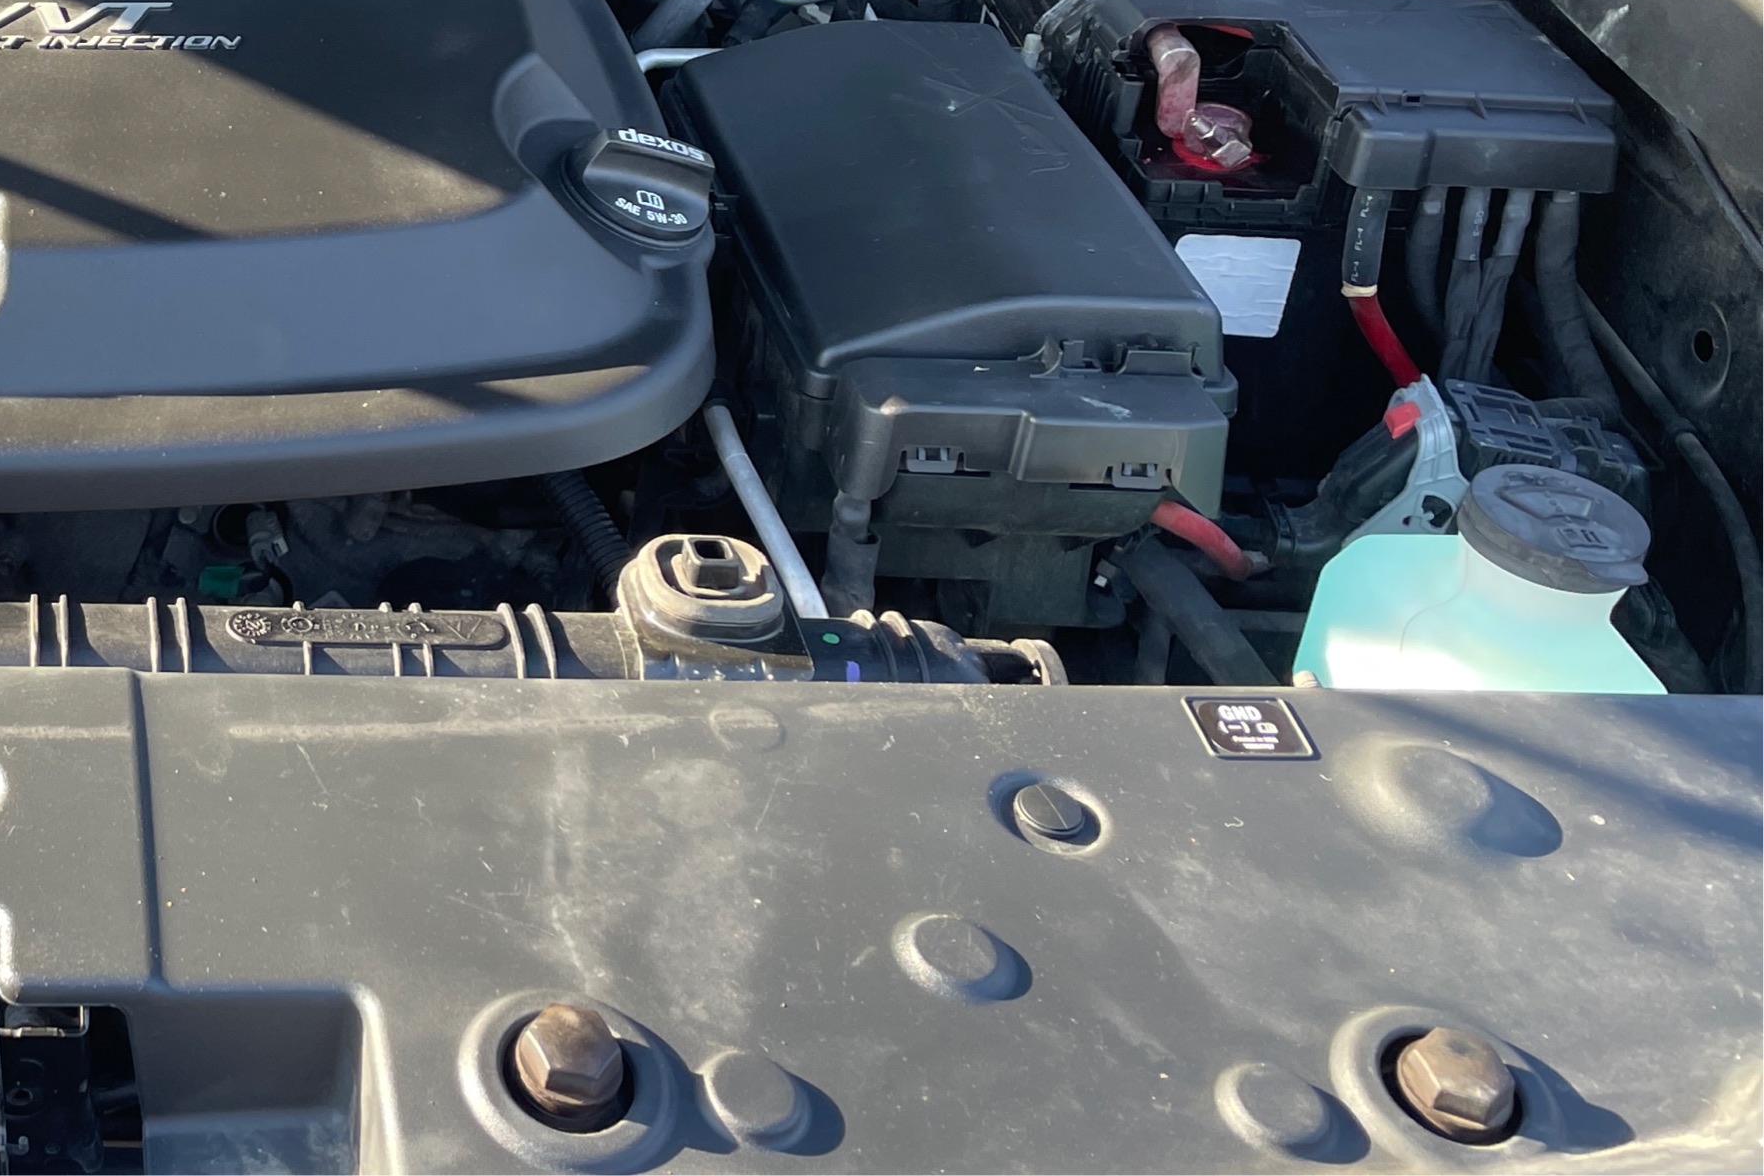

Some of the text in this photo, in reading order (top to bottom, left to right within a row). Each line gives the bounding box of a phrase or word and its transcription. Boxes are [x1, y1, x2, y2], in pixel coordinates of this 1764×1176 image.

[37, 35, 242, 50] INJECTION
[618, 128, 705, 162] dexos
[615, 197, 688, 225] SAE 5W-30
[1217, 705, 1262, 721] GND
